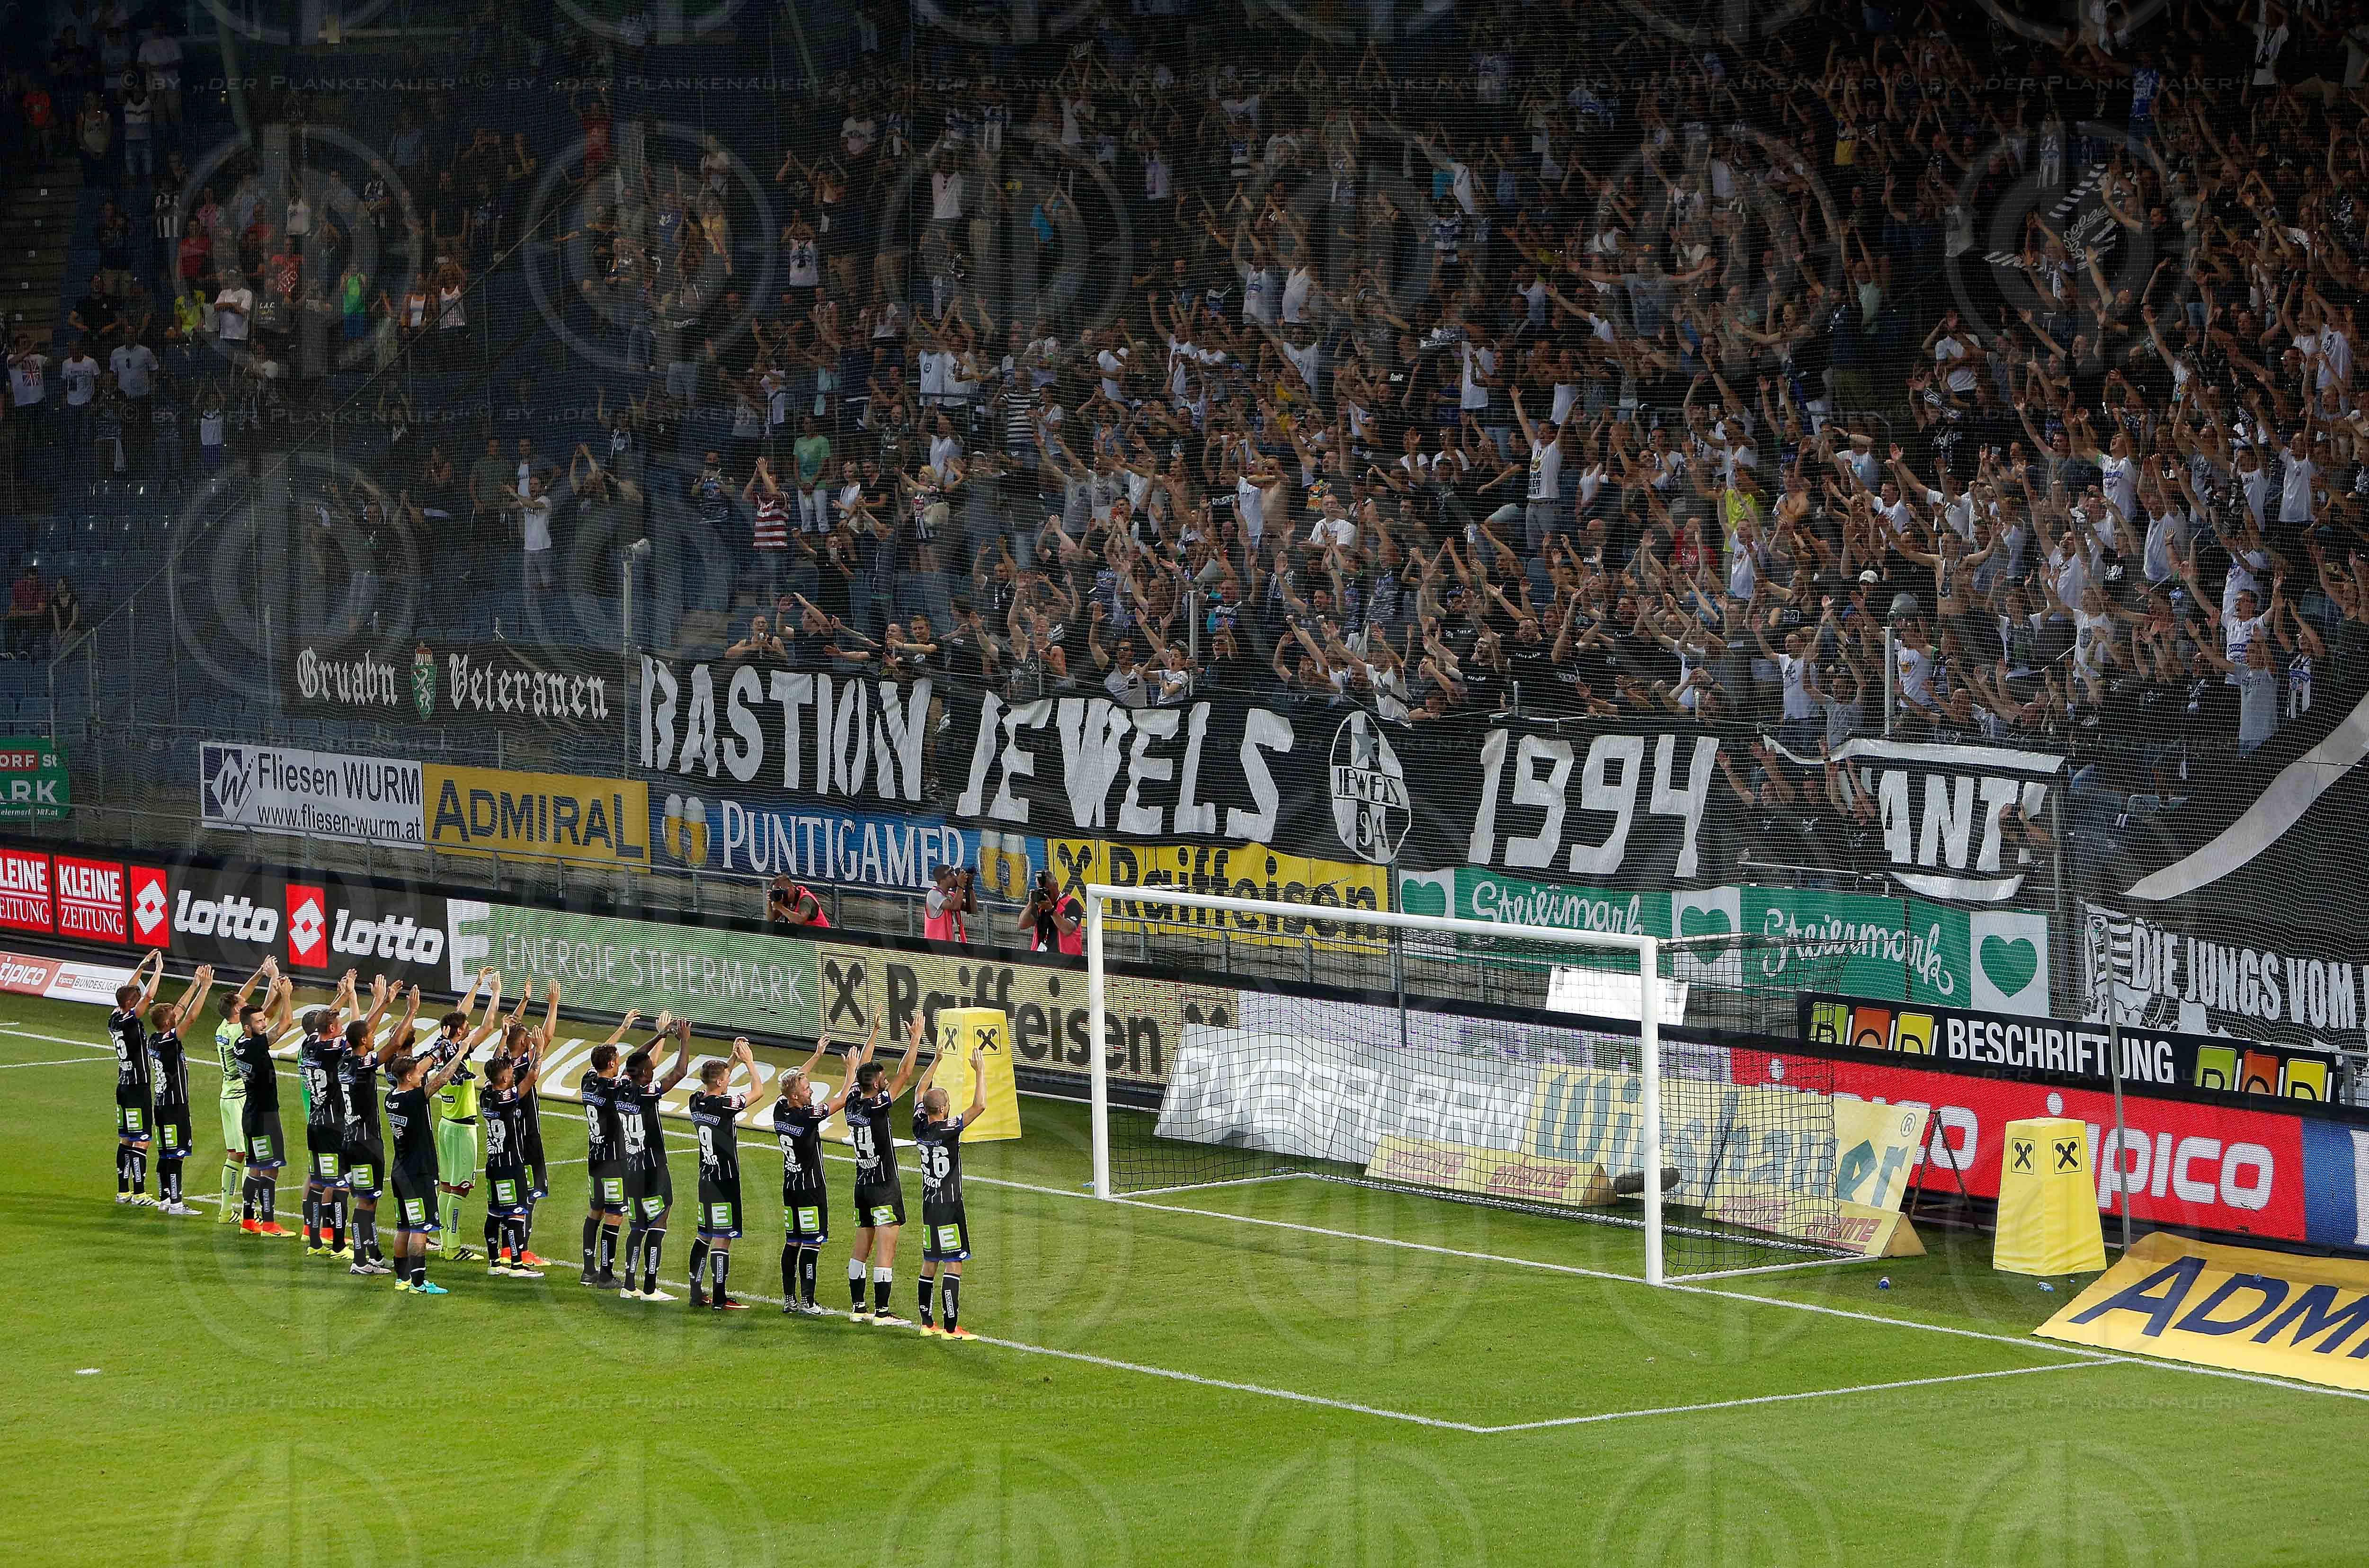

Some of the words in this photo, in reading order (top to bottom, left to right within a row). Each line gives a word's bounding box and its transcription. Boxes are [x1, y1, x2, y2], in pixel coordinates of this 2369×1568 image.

[258, 753, 338, 798] Fliesen
[343, 760, 420, 805] WURM
[639, 654, 932, 801] BASTION
[956, 689, 1294, 844] JEWELS
[1468, 728, 1719, 878] 1994
[258, 803, 421, 841] www.fliesen-wurm.at
[432, 780, 644, 859] ADMIRAL
[59, 864, 122, 902] KLEINE
[1109, 846, 1378, 940] Raiffeisen
[1472, 881, 1643, 935] Steiermark
[61, 905, 124, 935] ZEITUNG
[174, 890, 279, 944] lotto
[332, 909, 444, 967] lotto
[506, 935, 617, 983] ENERGIE
[629, 950, 806, 1007] STEIERMARK
[1763, 909, 1954, 995] Steiermark
[2132, 925, 2178, 998] DIE
[2185, 937, 2281, 1021] JUNGS
[2286, 958, 2357, 1028] VOM
[74, 977, 116, 991] BUNDESLIGA
[1947, 1018, 2175, 1084] BESCHRIFTUNG
[586, 1105, 601, 1136] 8
[1166, 1045, 1535, 1151] FLYERALARM
[698, 1125, 713, 1156] 9
[775, 1121, 803, 1136] UNTIGAMER
[780, 1134, 796, 1164] 6
[945, 1290, 954, 1317] PUNTIGAMER
